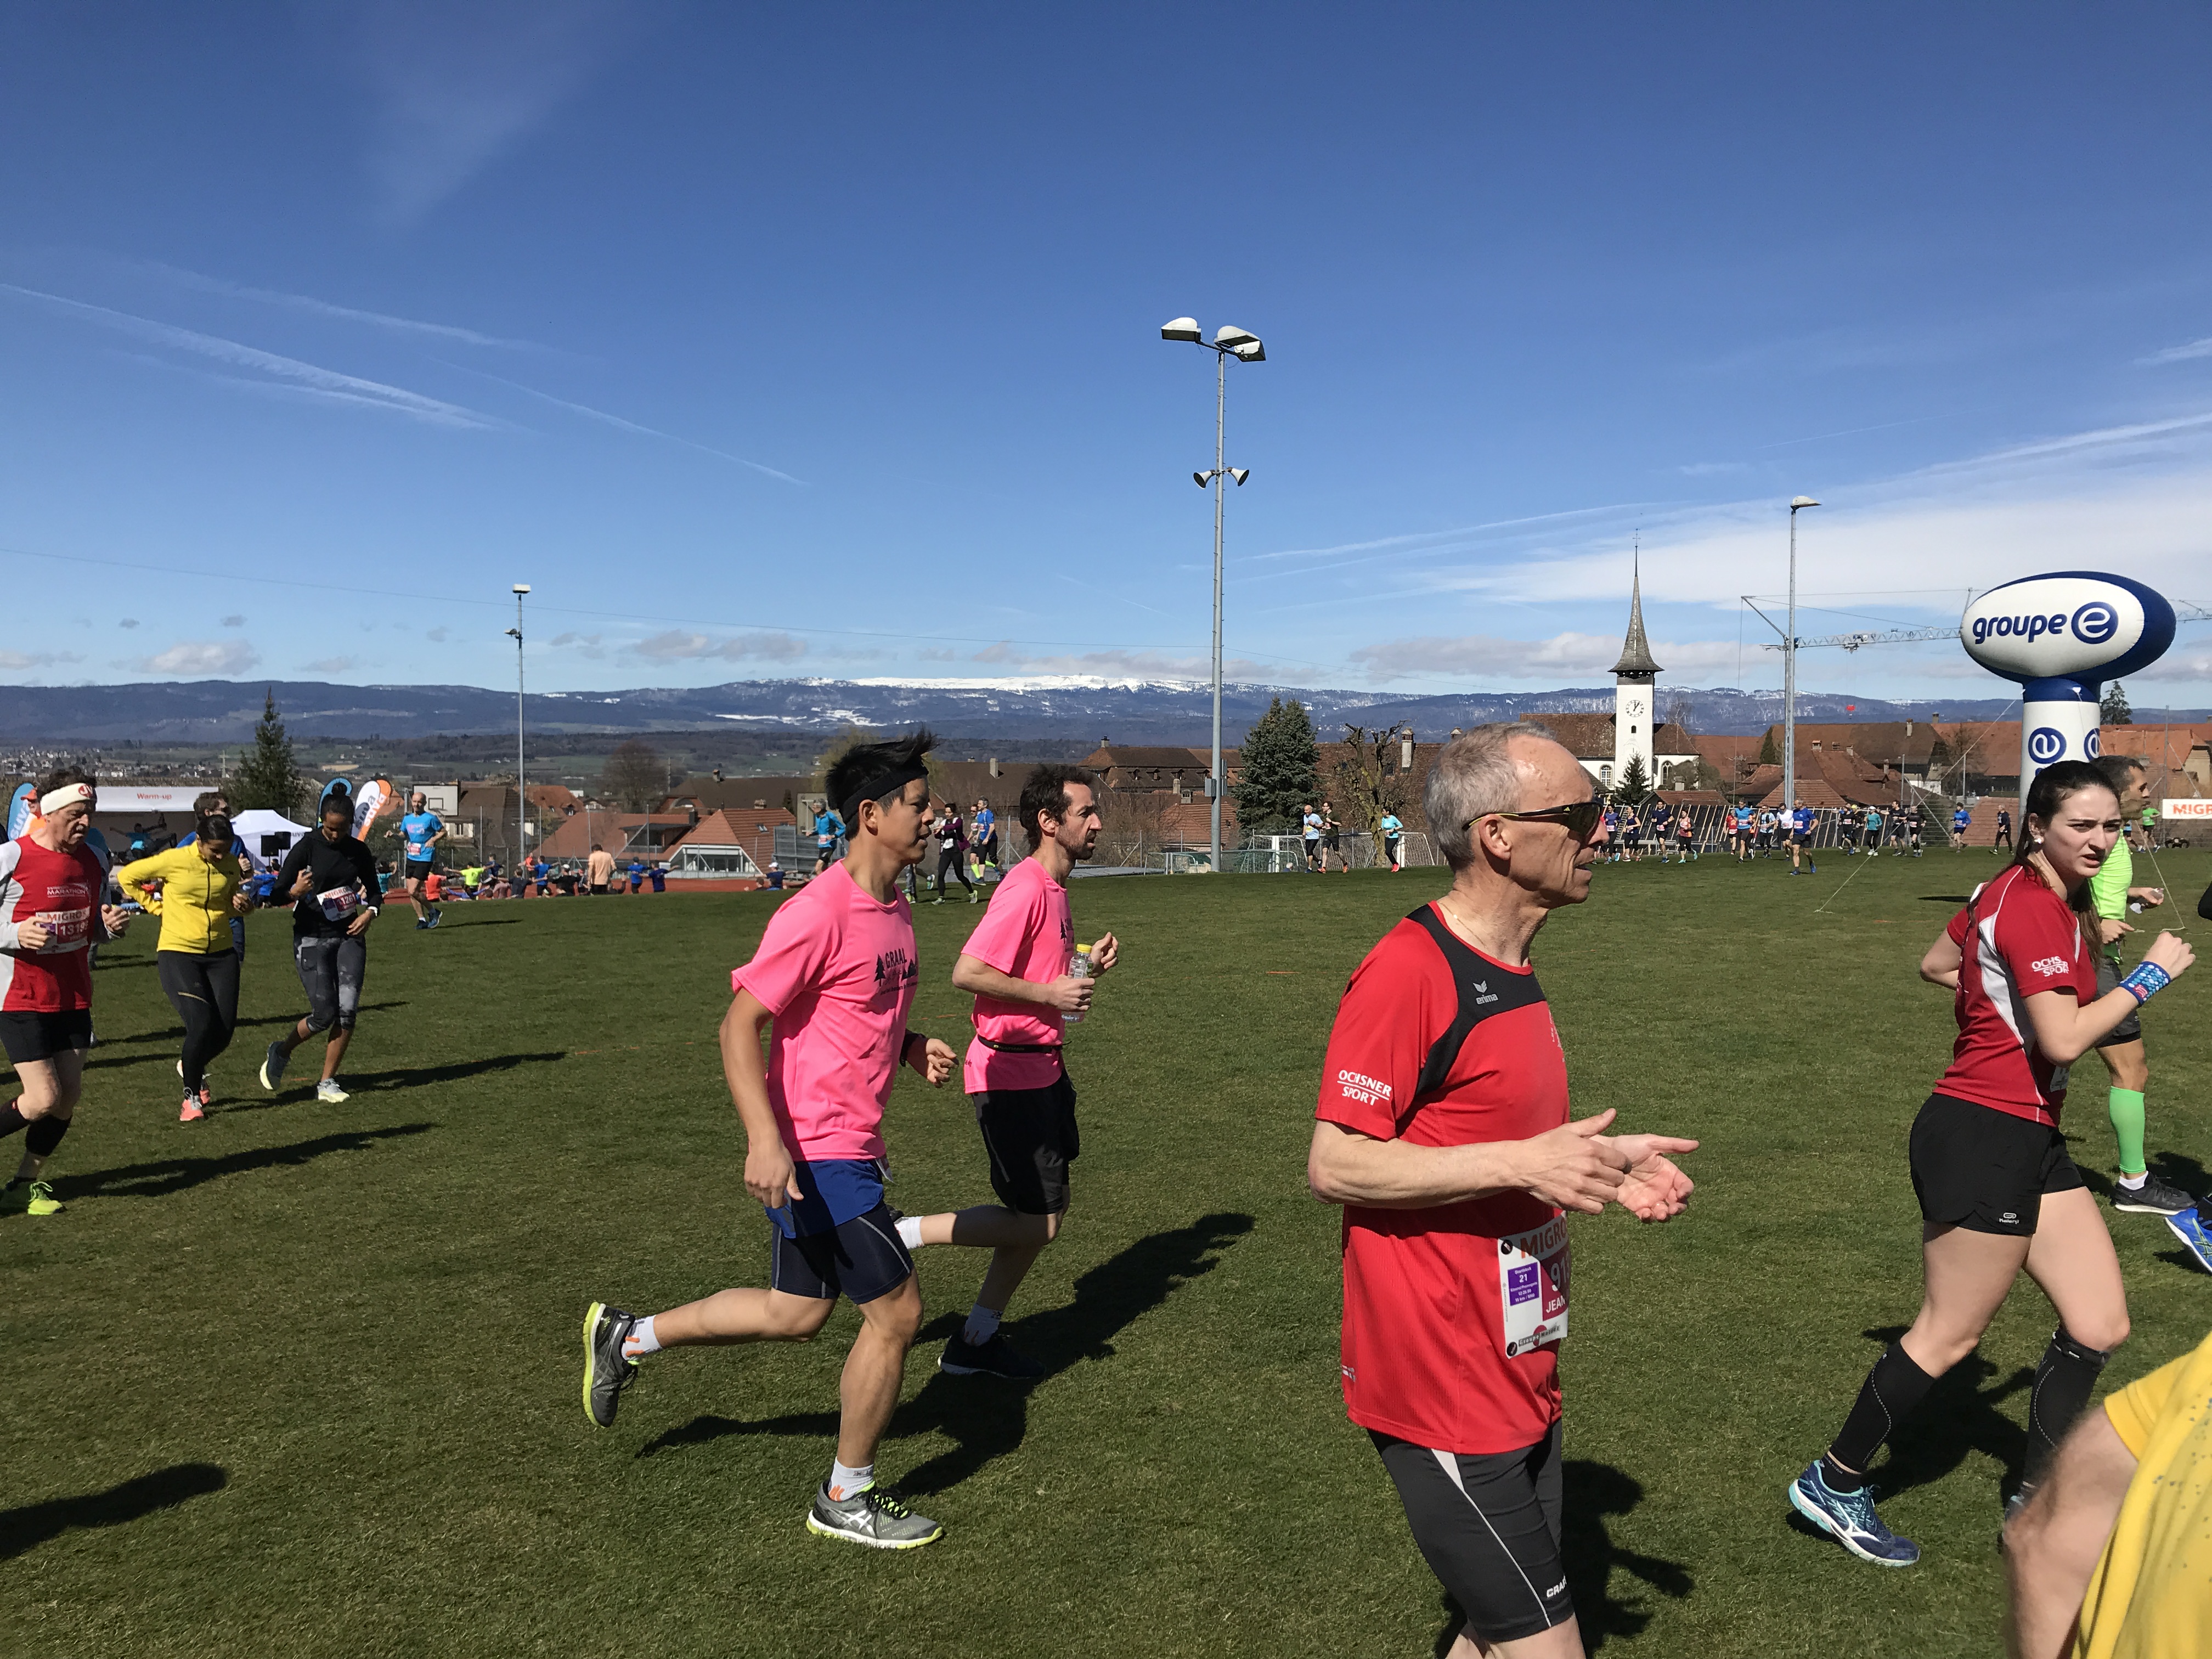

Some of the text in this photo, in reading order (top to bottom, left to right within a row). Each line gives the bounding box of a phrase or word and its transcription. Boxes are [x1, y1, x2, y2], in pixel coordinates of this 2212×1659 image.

[1972, 605, 2113, 645] groupe e
[364, 793, 386, 827] suva
[885, 947, 907, 969] GRAAL
[2032, 956, 2069, 970] OCHSR
[2042, 966, 2069, 977] SPOR
[1476, 994, 1499, 1005] erima
[1339, 1069, 1392, 1097] OCHSNER
[1342, 1086, 1379, 1106] SPORT
[1519, 1273, 1527, 1283] 21
[1519, 1334, 1540, 1345] Groupe
